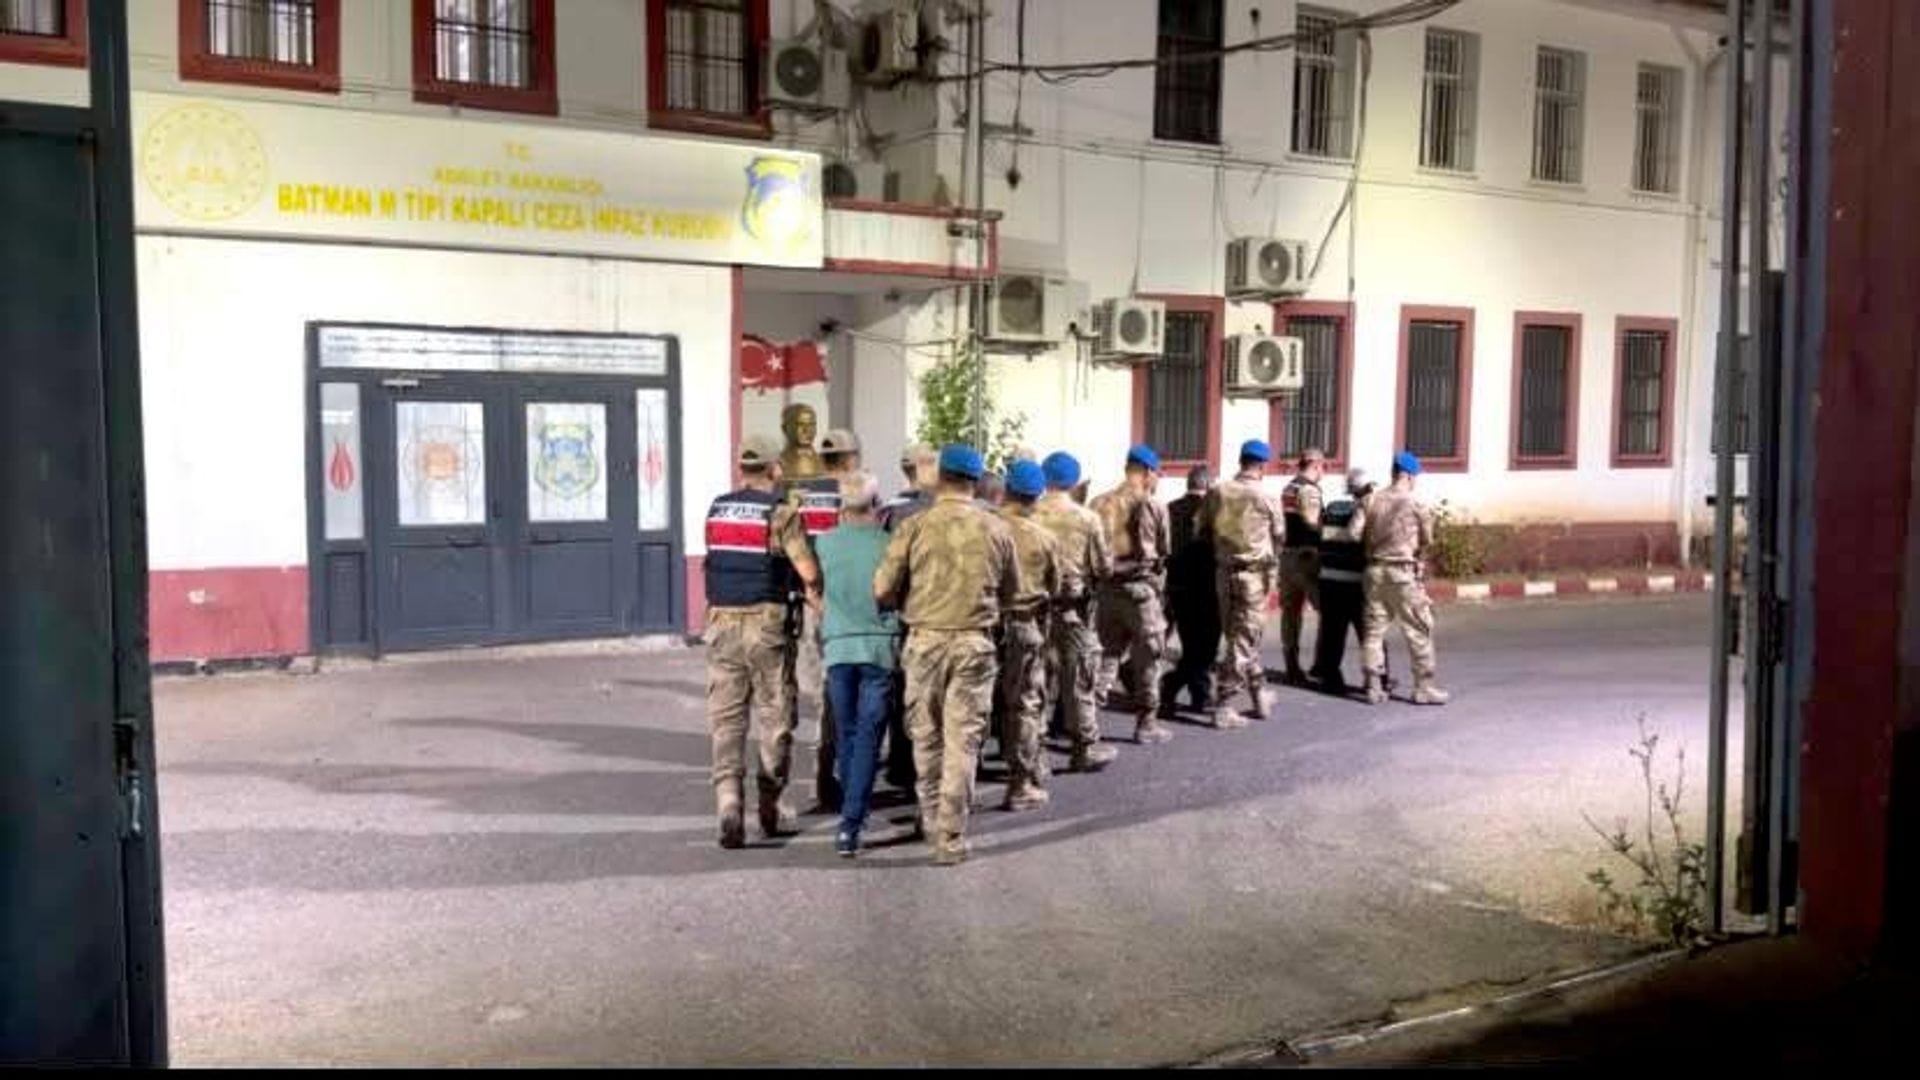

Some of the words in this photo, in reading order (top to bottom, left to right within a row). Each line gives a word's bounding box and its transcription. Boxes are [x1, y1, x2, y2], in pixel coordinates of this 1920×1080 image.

[278, 183, 372, 216] BATMAN
[451, 193, 526, 227] KAPALI
[533, 201, 585, 231] CEZA
